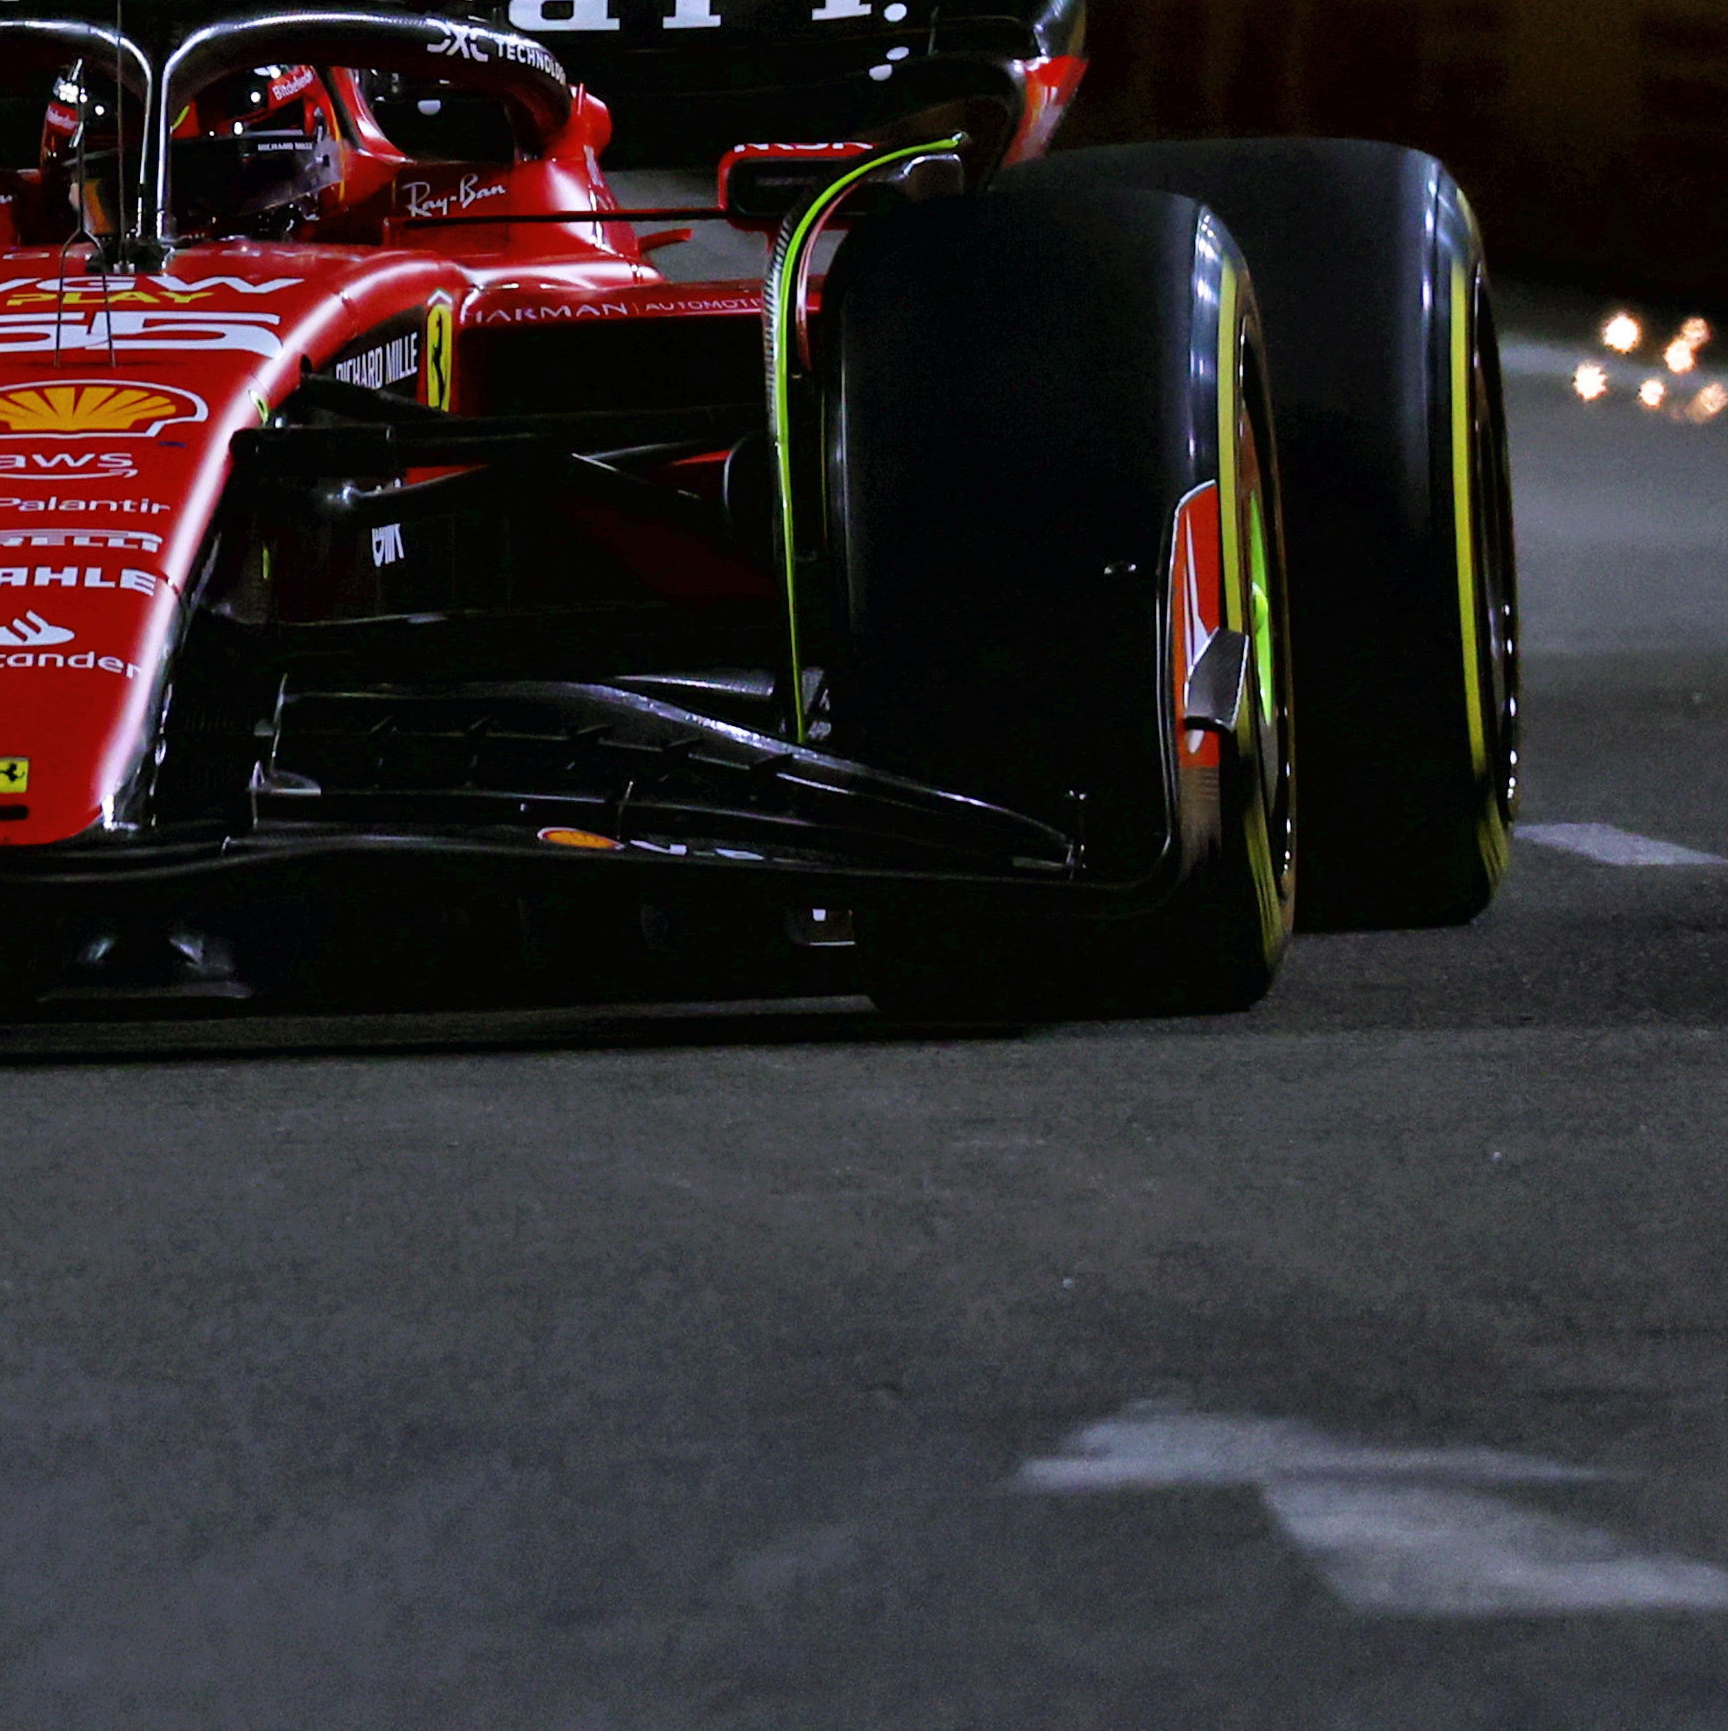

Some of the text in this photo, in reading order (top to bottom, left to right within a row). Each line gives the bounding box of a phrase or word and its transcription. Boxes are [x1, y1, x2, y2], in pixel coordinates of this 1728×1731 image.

[403, 173, 506, 217] Ray-Ban
[6, 291, 214, 306] PLAY
[460, 302, 628, 325] HARMAN
[336, 332, 418, 390] RICHARD MILLE
